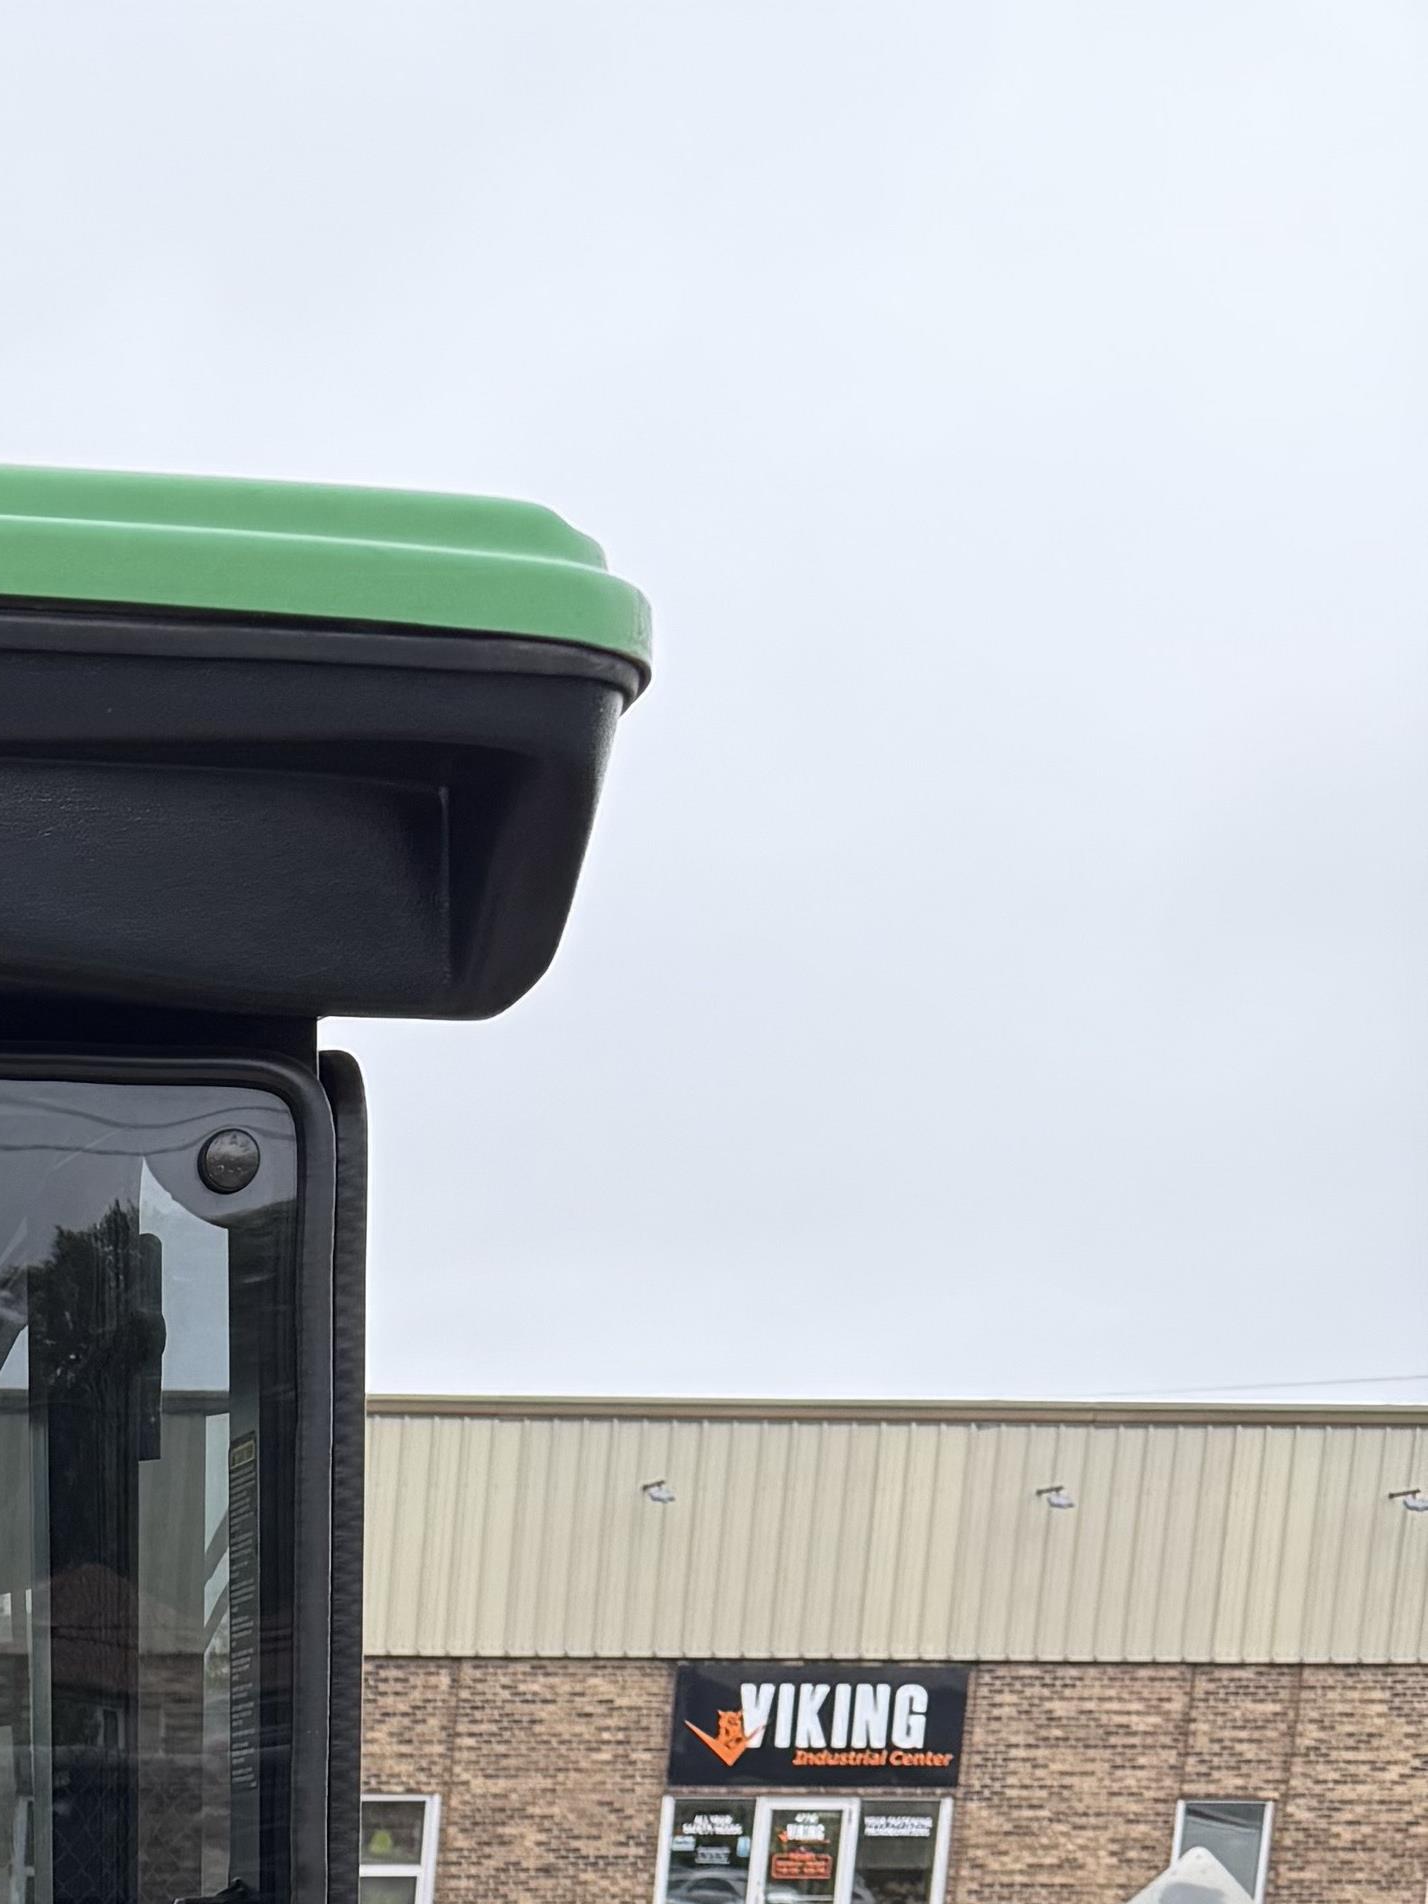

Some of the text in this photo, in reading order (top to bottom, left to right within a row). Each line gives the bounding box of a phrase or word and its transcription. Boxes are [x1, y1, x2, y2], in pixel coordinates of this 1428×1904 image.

[740, 1683, 928, 1749] VIKING
[792, 1750, 954, 1767] Industrial Center
